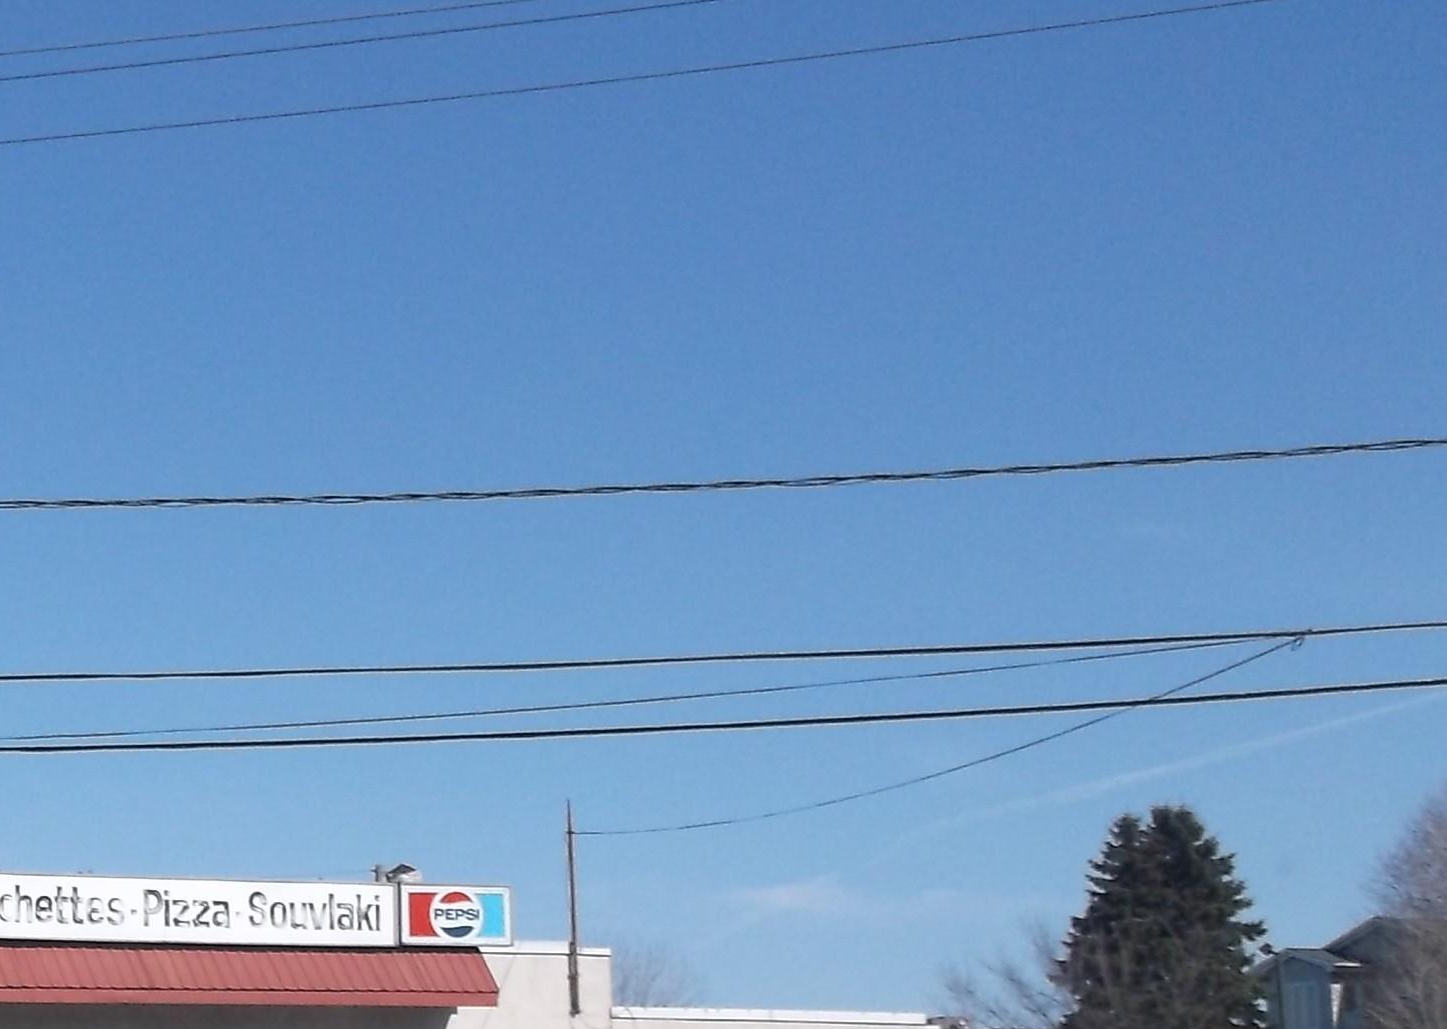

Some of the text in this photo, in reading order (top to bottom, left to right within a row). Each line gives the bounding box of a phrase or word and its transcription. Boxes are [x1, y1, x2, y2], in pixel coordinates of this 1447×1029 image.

[143, 889, 231, 928] Pizza
[248, 891, 381, 931] Souvlaki
[434, 907, 480, 921] PEPSI
